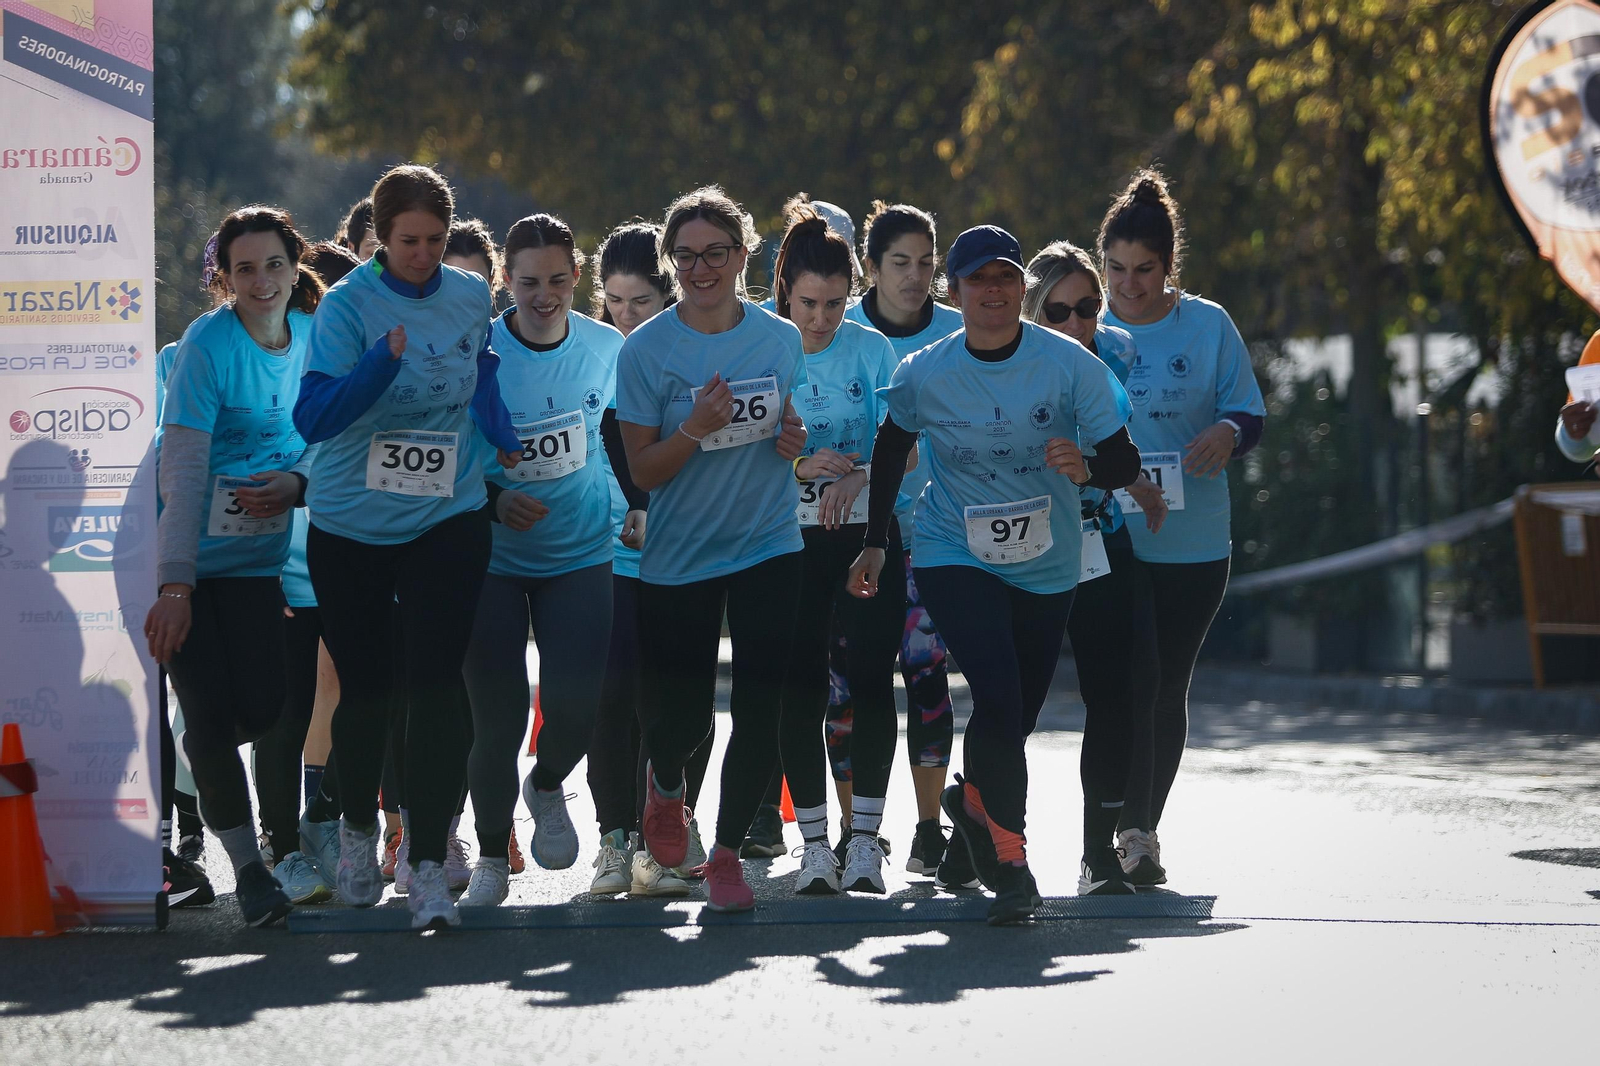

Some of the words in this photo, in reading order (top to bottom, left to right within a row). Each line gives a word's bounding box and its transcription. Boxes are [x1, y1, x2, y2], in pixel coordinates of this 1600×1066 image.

[381, 443, 445, 473] 309
[521, 430, 571, 462] 301
[991, 515, 1031, 543] 97
